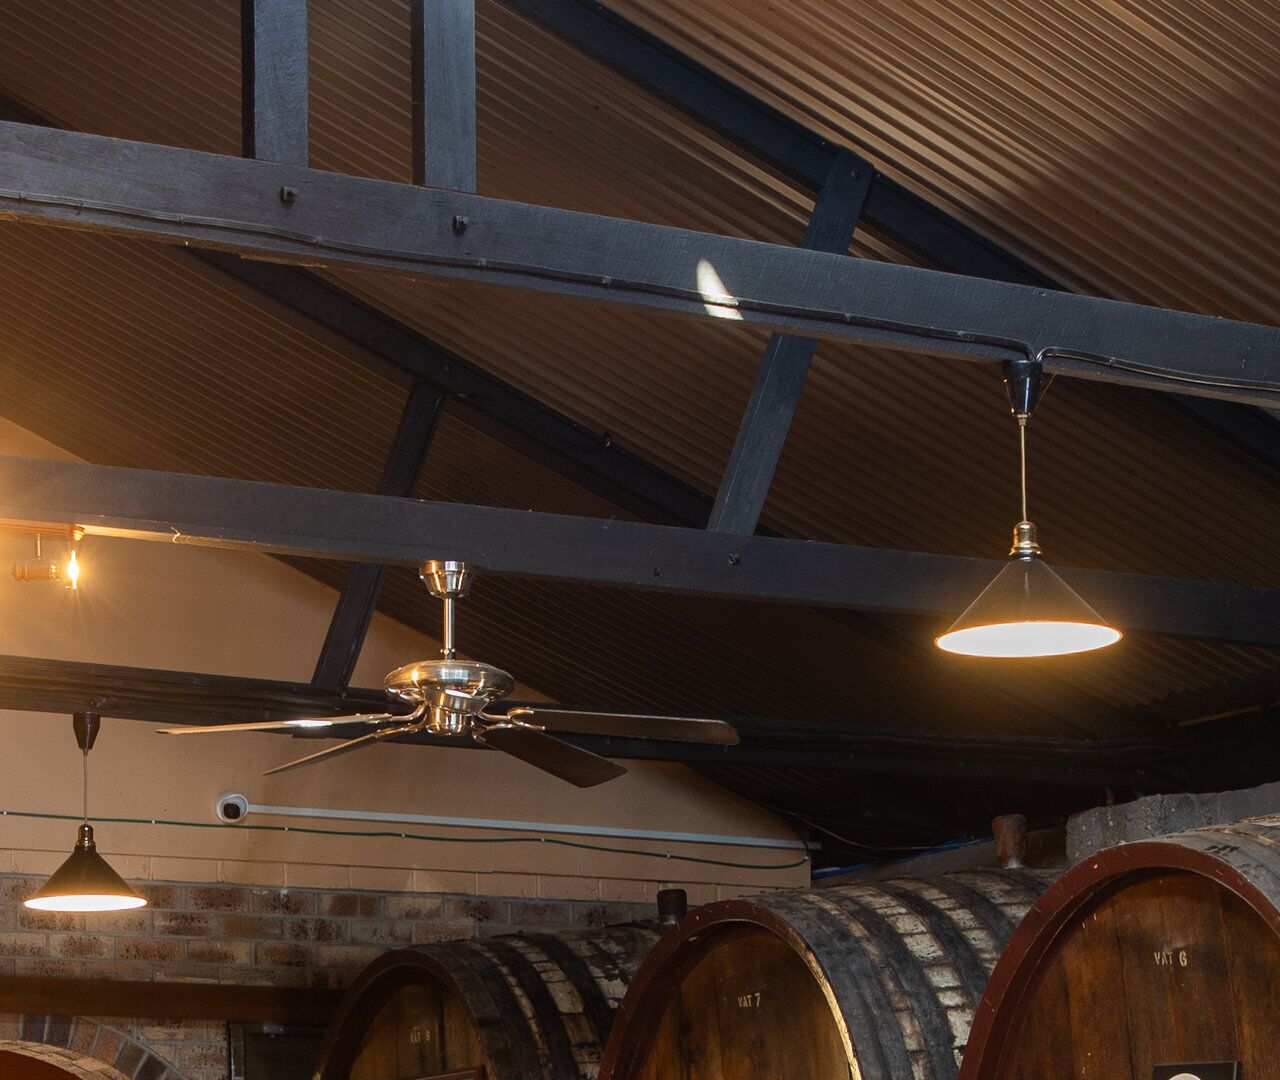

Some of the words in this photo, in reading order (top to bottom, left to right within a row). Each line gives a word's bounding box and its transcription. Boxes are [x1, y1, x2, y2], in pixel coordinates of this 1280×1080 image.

[1153, 951, 1173, 966] VAT
[737, 994, 752, 1008] VAT
[754, 991, 761, 1007] 7
